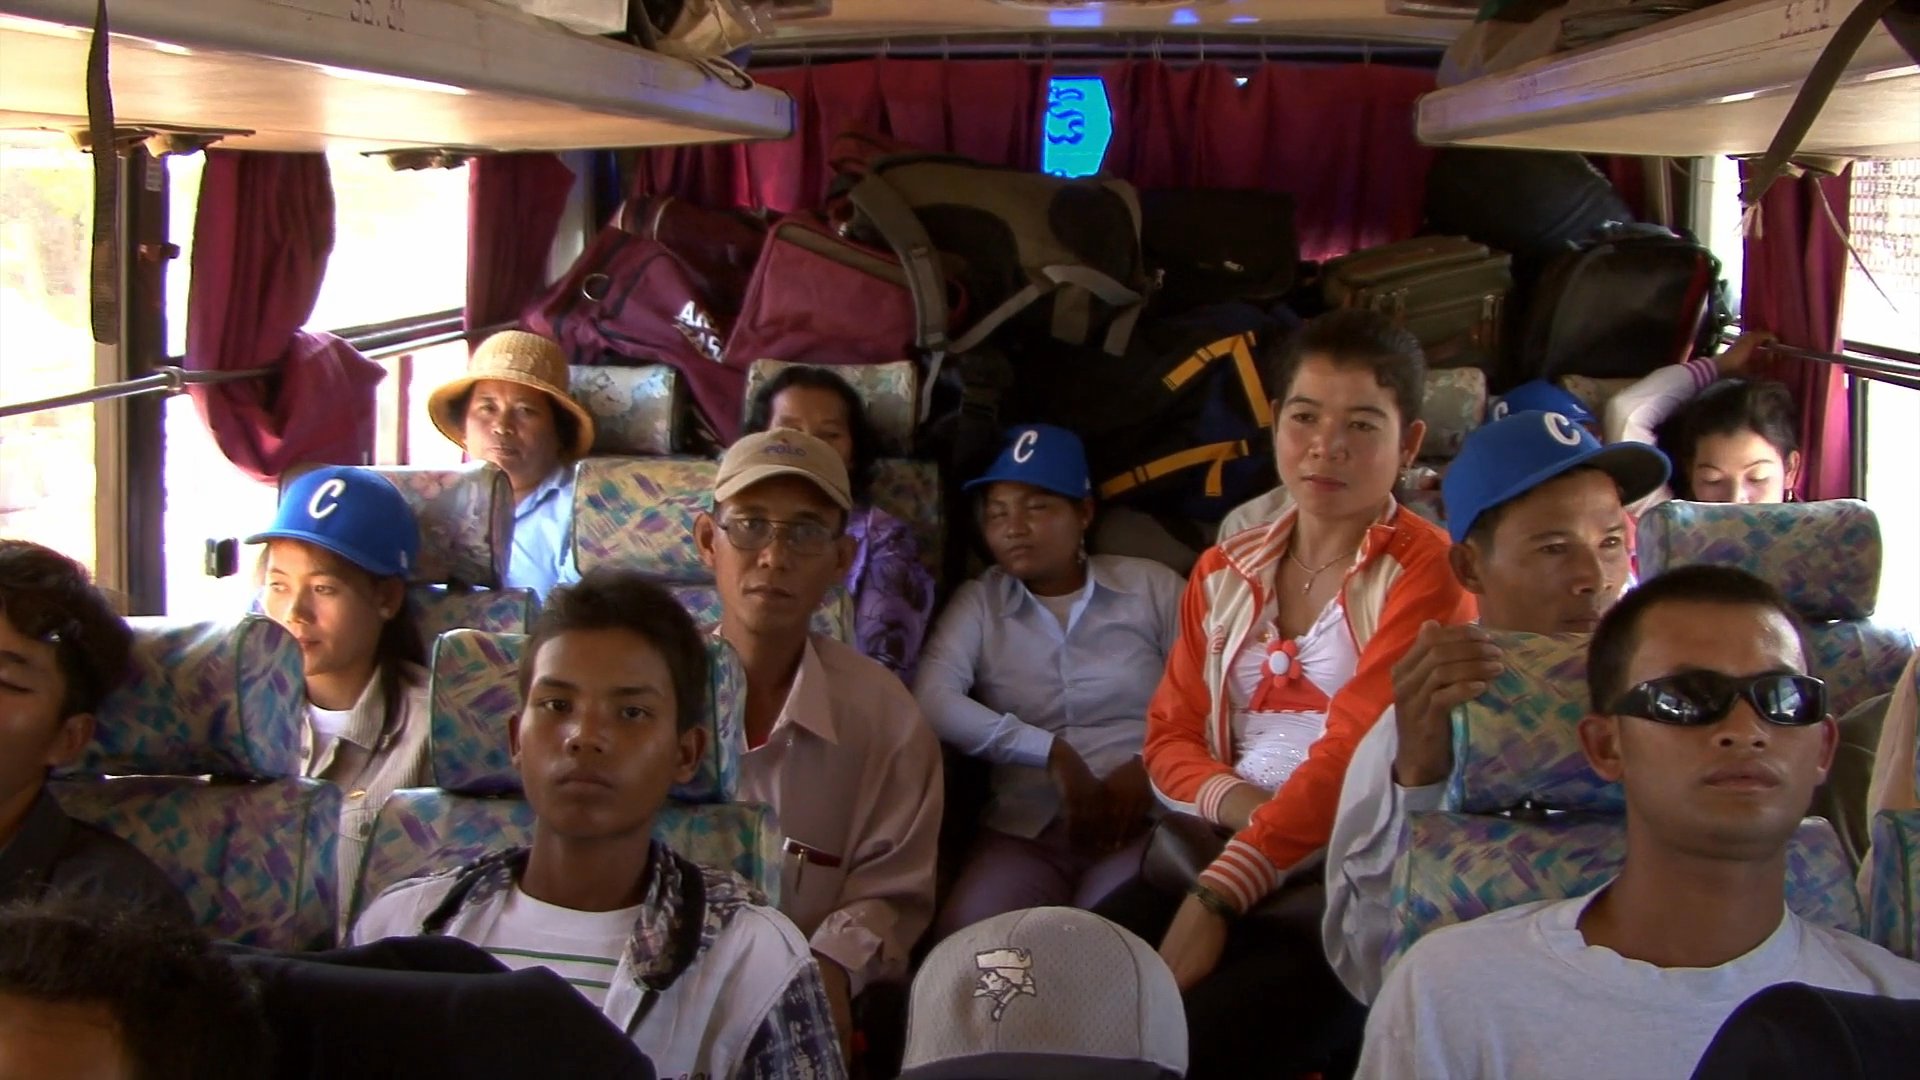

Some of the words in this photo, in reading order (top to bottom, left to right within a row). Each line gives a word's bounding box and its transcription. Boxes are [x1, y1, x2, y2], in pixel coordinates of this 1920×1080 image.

[1544, 411, 1581, 446] C
[1014, 429, 1039, 464] C
[308, 478, 347, 519] C
